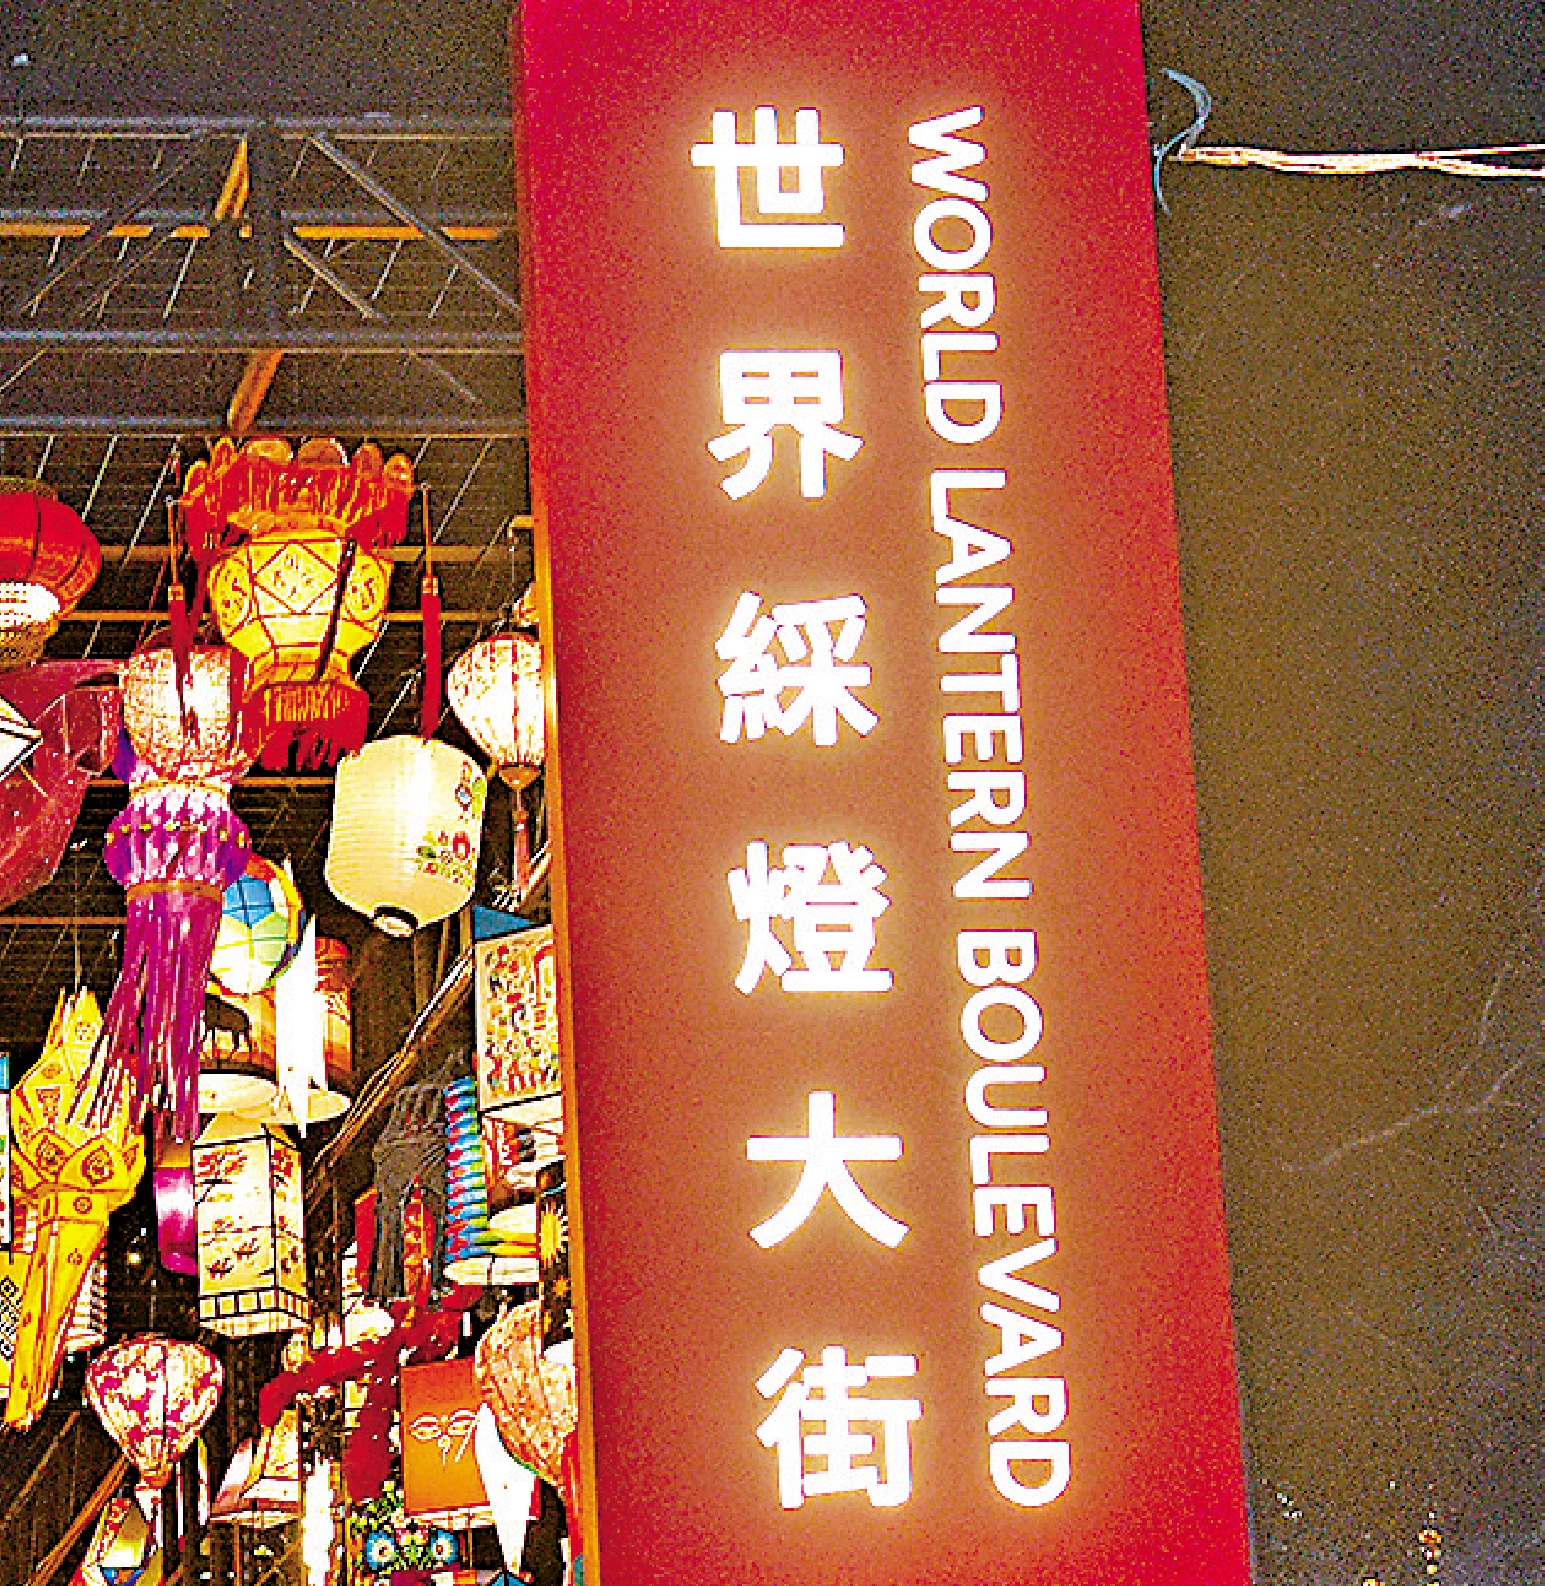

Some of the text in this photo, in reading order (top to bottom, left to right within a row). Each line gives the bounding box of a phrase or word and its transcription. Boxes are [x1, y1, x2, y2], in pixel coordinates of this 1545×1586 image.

[689, 105, 923, 1510] 世界綵燈大街
[907, 105, 1071, 1508] WORLD LANTERN BOULEVARD
